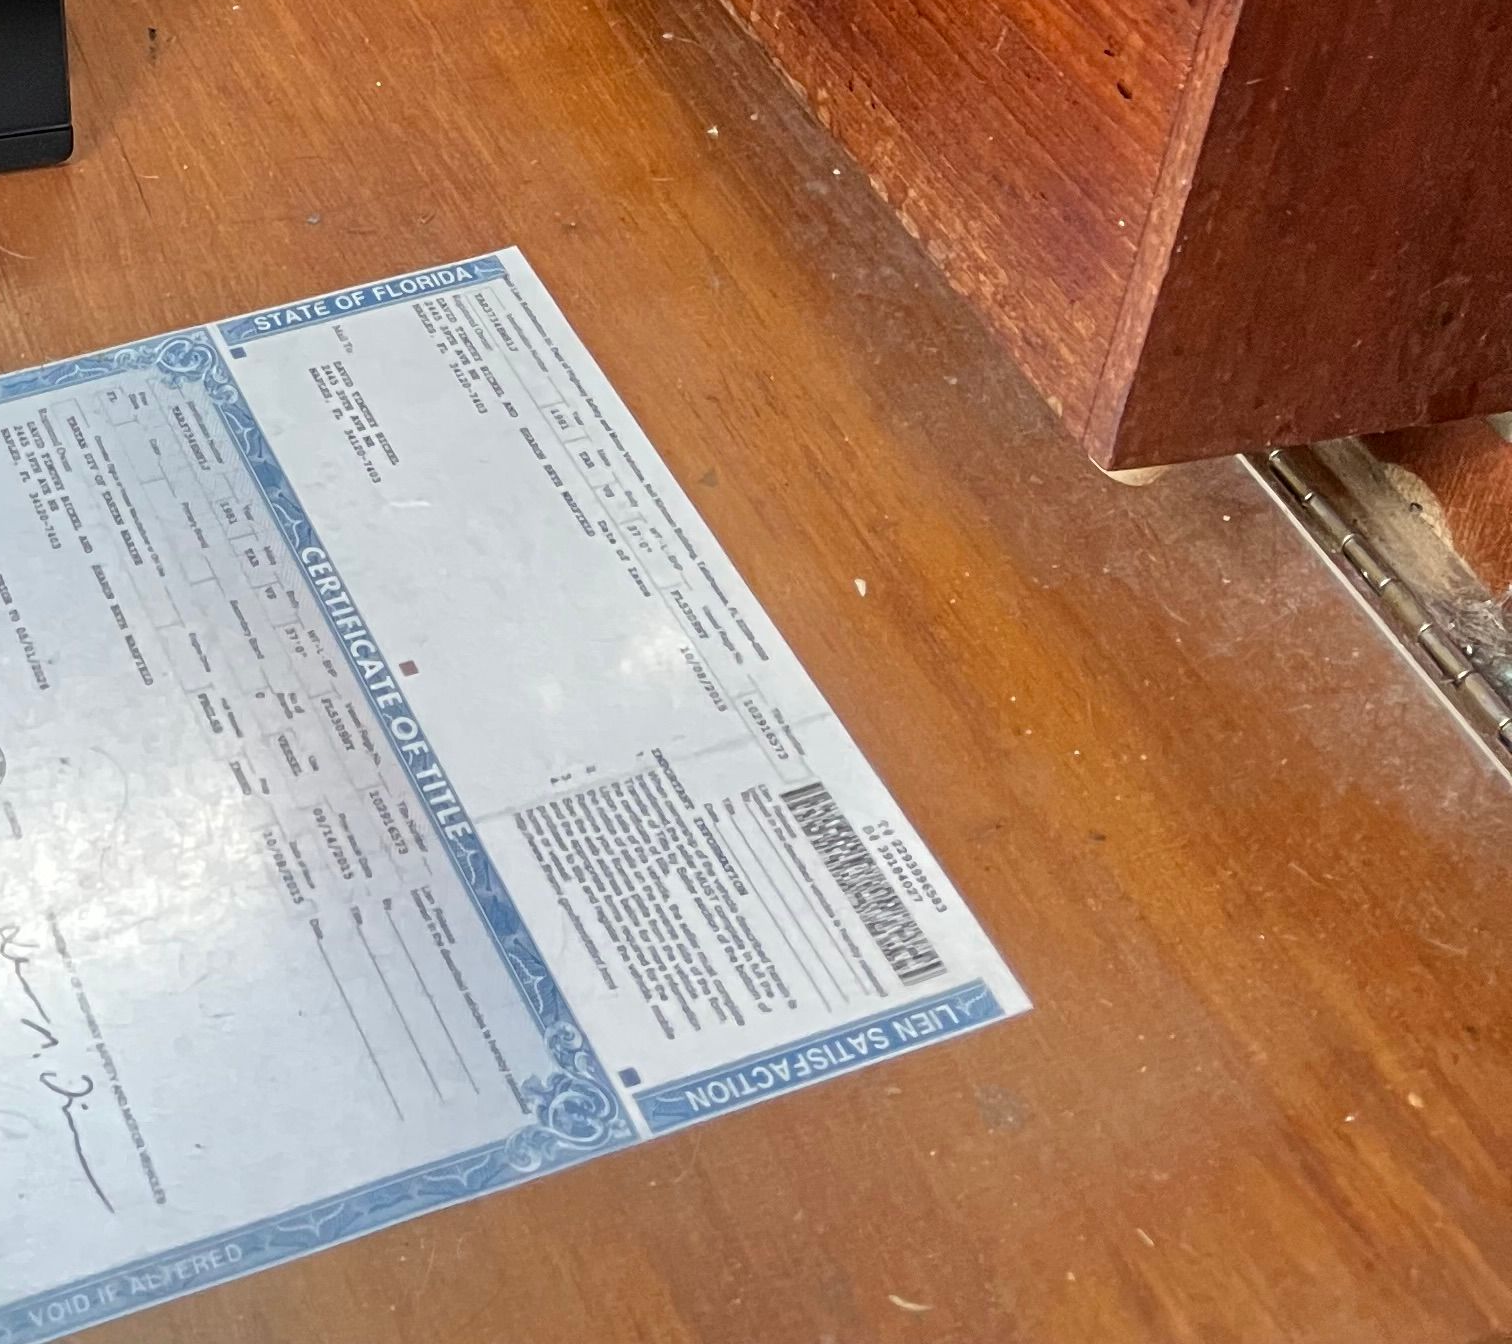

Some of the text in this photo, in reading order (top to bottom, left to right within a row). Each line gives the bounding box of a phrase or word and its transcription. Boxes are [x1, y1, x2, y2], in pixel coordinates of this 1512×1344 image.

[253, 265, 474, 334] STATE OF FLORIDA
[294, 543, 476, 840] CERTIFICATE OF TITLE
[683, 1004, 960, 1112] LIEN SATISFACTION
[29, 1243, 244, 1330] VOID IF ALTERED
